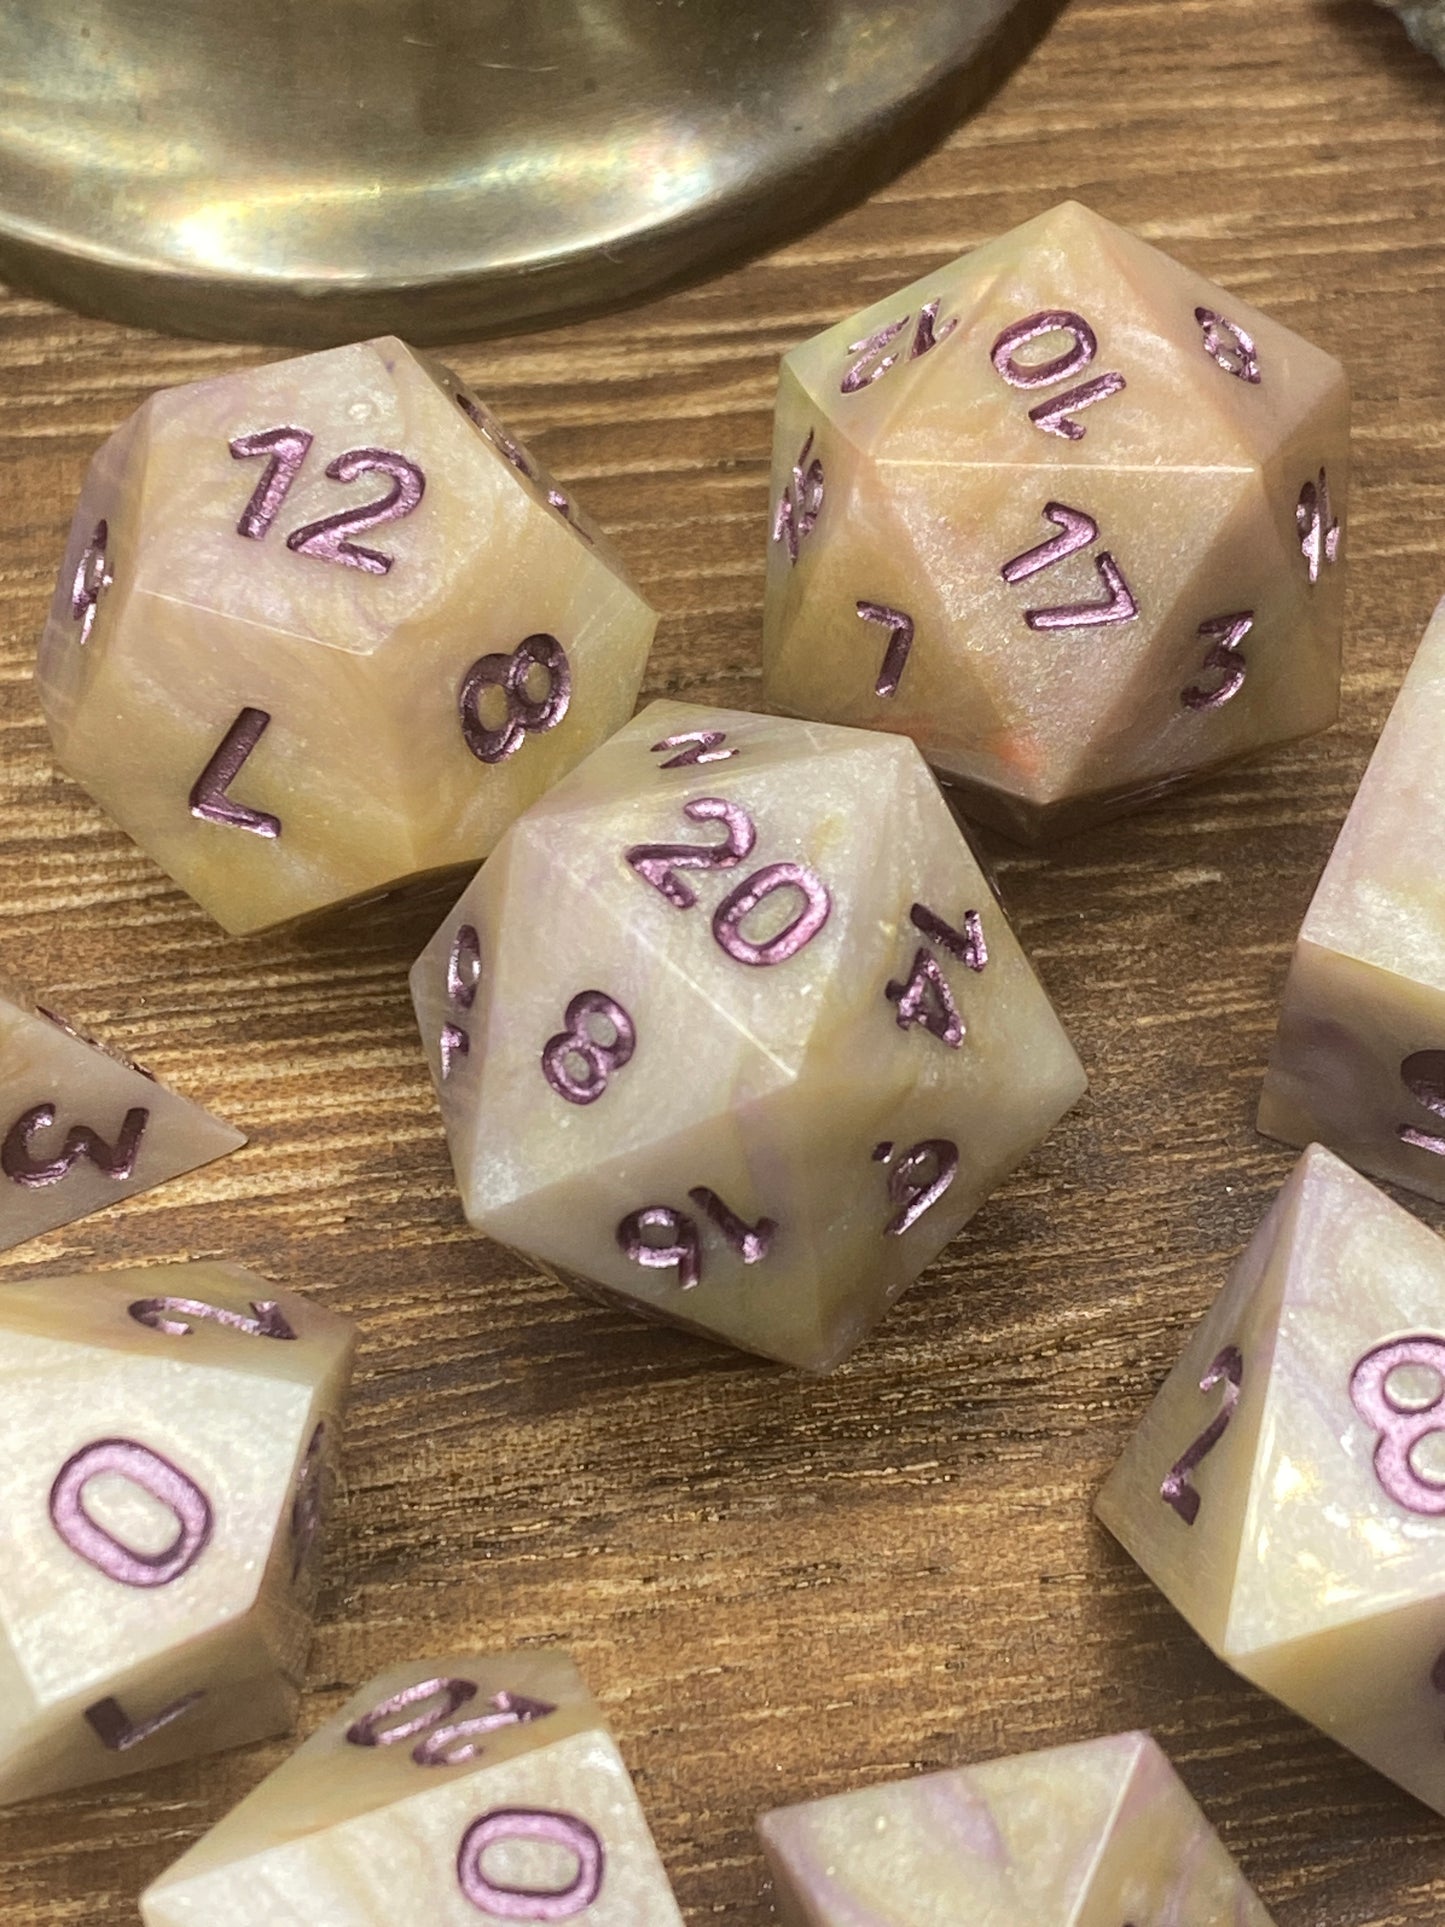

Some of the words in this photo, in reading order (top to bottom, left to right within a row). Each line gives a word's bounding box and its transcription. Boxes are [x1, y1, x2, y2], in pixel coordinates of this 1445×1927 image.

[990, 308, 1127, 440] 10
[228, 425, 426, 575] 12
[1001, 500, 1139, 632] 17
[458, 632, 571, 764] 8
[856, 600, 914, 698] 7
[1180, 609, 1255, 711] 3
[188, 706, 282, 839] 7
[625, 797, 832, 967] 20
[884, 901, 989, 1050] 14
[540, 989, 637, 1106] 8
[0, 1103, 150, 1188] 3
[616, 1184, 779, 1290] 16
[1160, 1344, 1243, 1527] 2
[50, 1436, 213, 1589] 0
[346, 1677, 559, 1768] 20
[455, 1807, 606, 1922] 0
